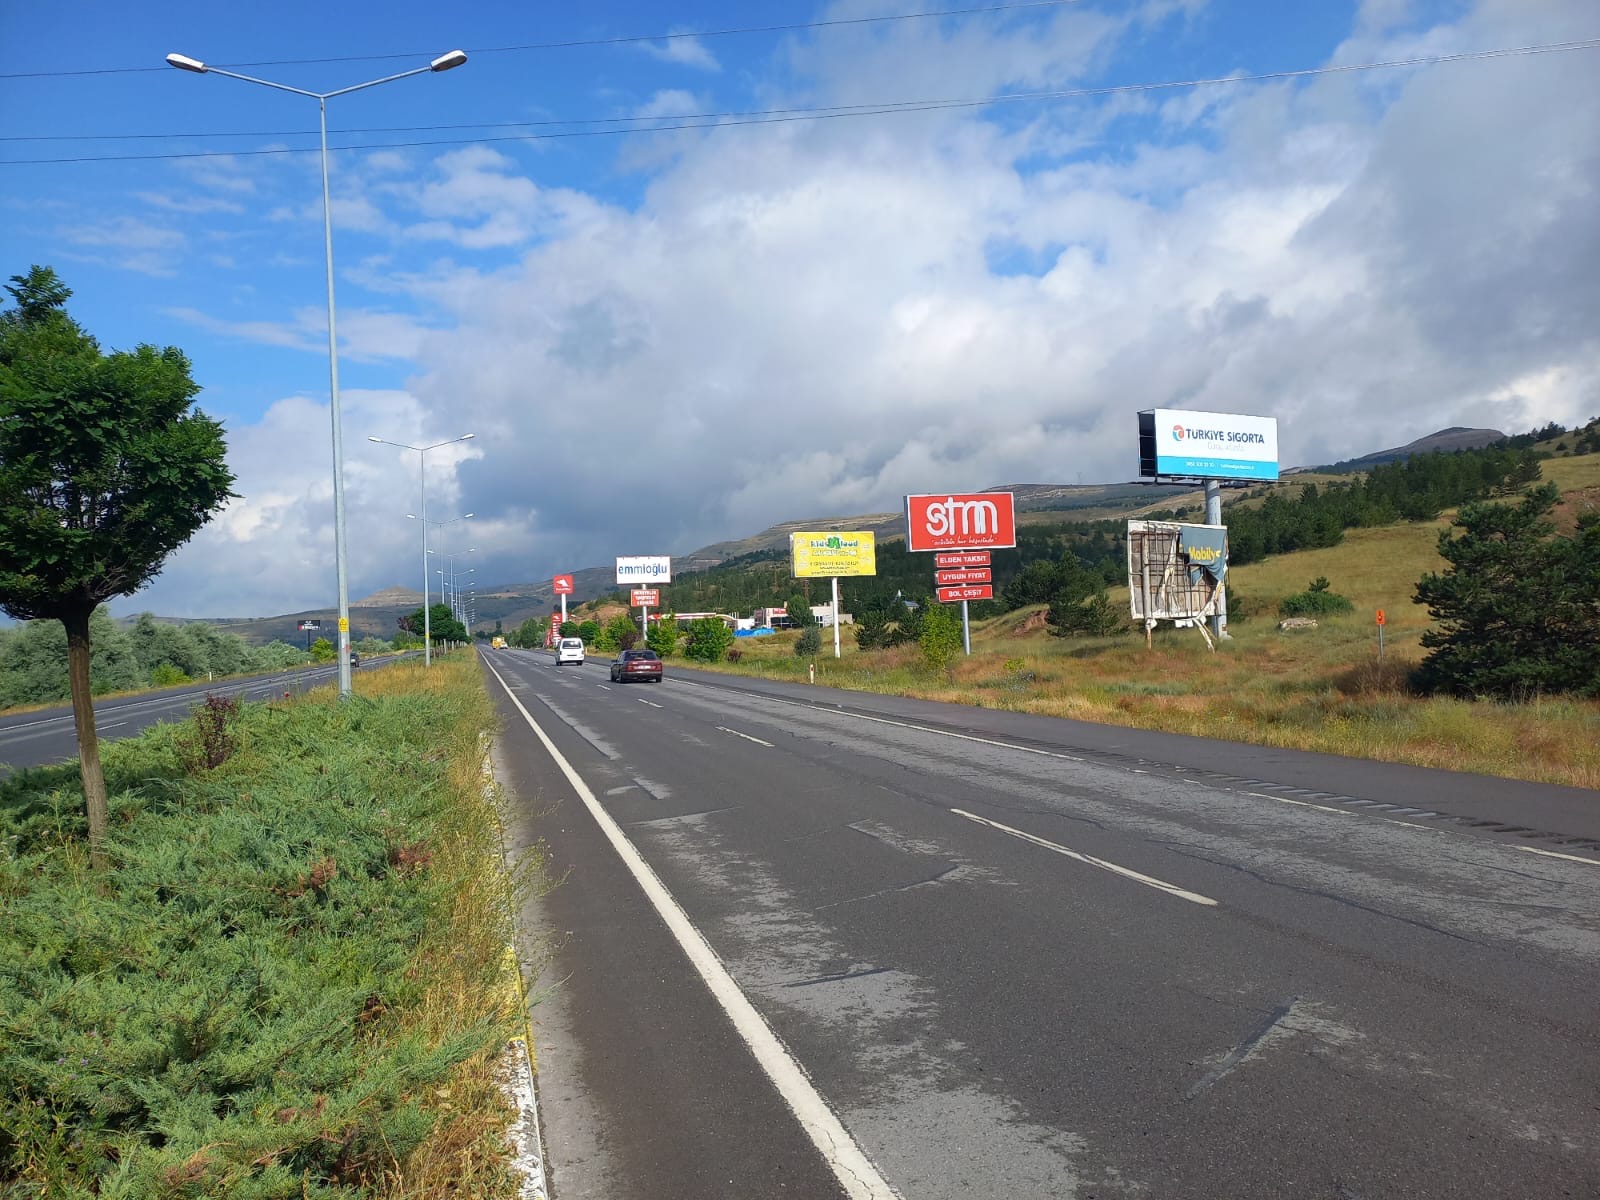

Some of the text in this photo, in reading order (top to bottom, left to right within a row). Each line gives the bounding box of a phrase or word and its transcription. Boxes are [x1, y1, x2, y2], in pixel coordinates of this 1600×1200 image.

[1186, 428, 1264, 444] TÜRKİYE SİGORTA
[939, 556, 962, 564] ELDEN
